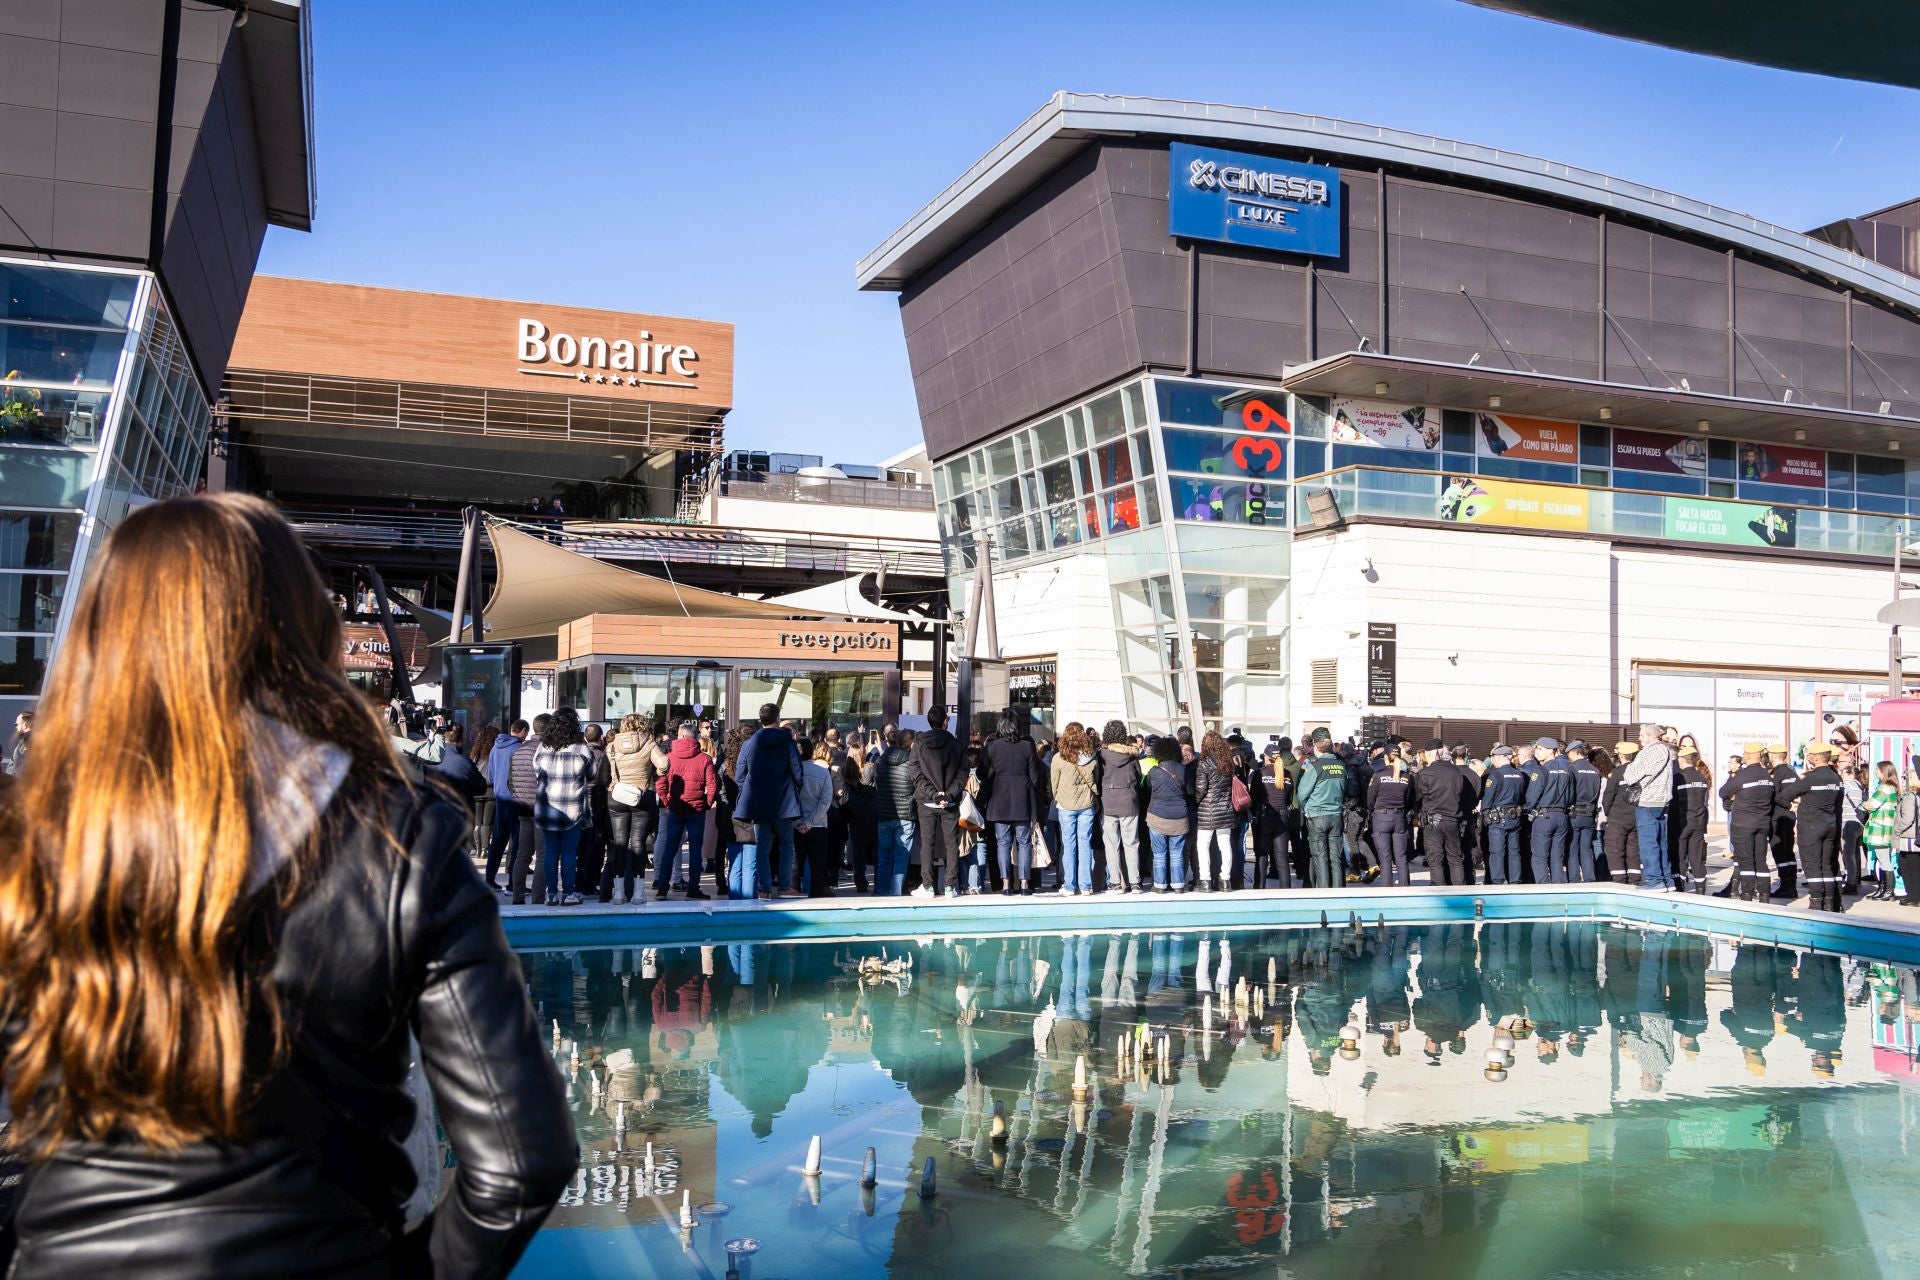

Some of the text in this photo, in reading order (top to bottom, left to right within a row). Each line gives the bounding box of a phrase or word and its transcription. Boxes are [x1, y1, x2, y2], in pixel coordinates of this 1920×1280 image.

[1218, 166, 1328, 203] CINESA
[1239, 205, 1287, 224] LUXE
[518, 318, 697, 376] Bonaire
[1231, 399, 1291, 473] 39
[1538, 429, 1558, 440] VUELA
[1522, 440, 1574, 454] COMO UN PÁJARO
[1617, 444, 1661, 457] ESCAPA SI PUEDES
[1781, 466, 1788, 474] UN
[1788, 467, 1804, 475] PARQUE
[1804, 468, 1810, 476] DE
[1504, 497, 1583, 516] SUPÉRATE ESCALANDO
[1678, 506, 1723, 521] SALTA HASTA
[1675, 520, 1727, 535] TOCAR EL CIELO
[360, 637, 391, 653] cine
[778, 631, 891, 653] recepción
[1375, 644, 1383, 661] 1
[1737, 688, 1765, 699] Bonaire
